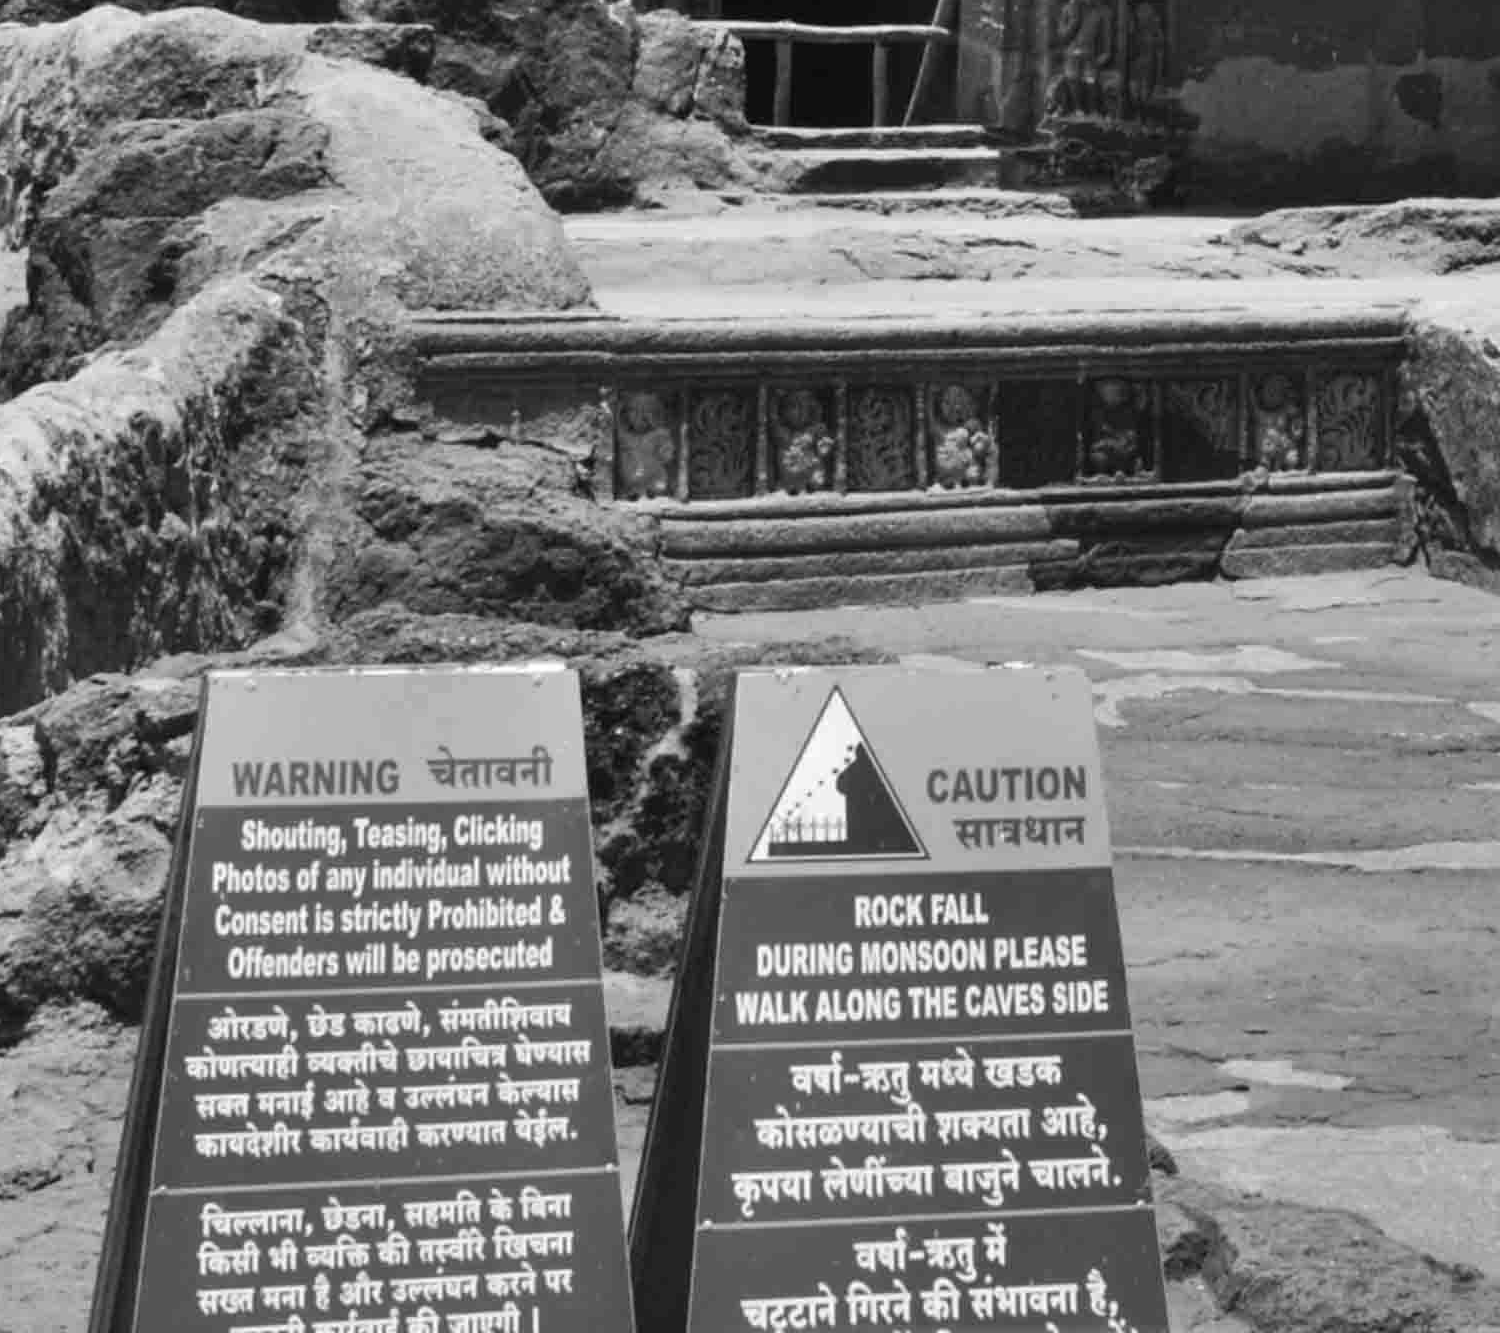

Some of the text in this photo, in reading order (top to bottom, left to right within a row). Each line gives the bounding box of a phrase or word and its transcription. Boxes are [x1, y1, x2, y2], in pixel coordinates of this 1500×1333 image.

[233, 746, 552, 796] WARNING चेतावनी
[927, 766, 1086, 804] CAUTION
[240, 812, 544, 858] Shouting, Teasing, Clicking
[952, 815, 1086, 849] सावधान
[211, 853, 572, 899] Photos of any individual without
[214, 893, 567, 940] Consent is strictly Prohibited &
[854, 892, 990, 929] ROCK FALL
[227, 935, 554, 980] Offenders will be prosecuted
[756, 934, 1088, 978] DURING MONSOON PLEASE
[207, 1004, 299, 1045] ओरडणे,
[305, 1004, 347, 1038] छेड
[734, 979, 1109, 1026] WALK ALONG THE CAVES SIDE
[183, 1032, 593, 1081] कोणत्याही व्यक्तीचे छायाचित्र घेण्यास
[916, 1046, 976, 1090] मध्ये
[981, 1054, 1062, 1089] खडक
[255, 1079, 316, 1121] मनाई
[323, 1077, 372, 1116] आहे
[375, 1086, 397, 1110] व
[401, 1073, 491, 1110] उल्लंघन
[494, 1071, 581, 1106] केल्यास
[193, 1120, 303, 1158] कायदेशीर
[307, 1116, 410, 1153] कार्यवाही
[414, 1119, 509, 1148] करण्यात
[753, 1092, 1108, 1150] कोसळण्याची शक्यता आहे,
[730, 1169, 814, 1219] कृपया
[819, 1154, 935, 1201] लेणींच्या
[940, 1148, 1021, 1207] बाजुने
[199, 1201, 314, 1238] चिल्लाना,
[402, 1188, 483, 1229] सहमति
[487, 1187, 514, 1222] के
[518, 1184, 573, 1221] बिना
[195, 1239, 261, 1276] किसी
[267, 1237, 299, 1272] भी
[303, 1233, 371, 1270] व्यक्ति
[375, 1227, 413, 1266] की
[982, 1222, 1008, 1267] में
[195, 1260, 573, 1316] सख्त मना है और उल्लंघन करने पर
[844, 1278, 912, 1326] गिरने
[919, 1276, 962, 1322] की
[965, 1269, 1079, 1320] संभावना
[1084, 1268, 1119, 1323] है,
